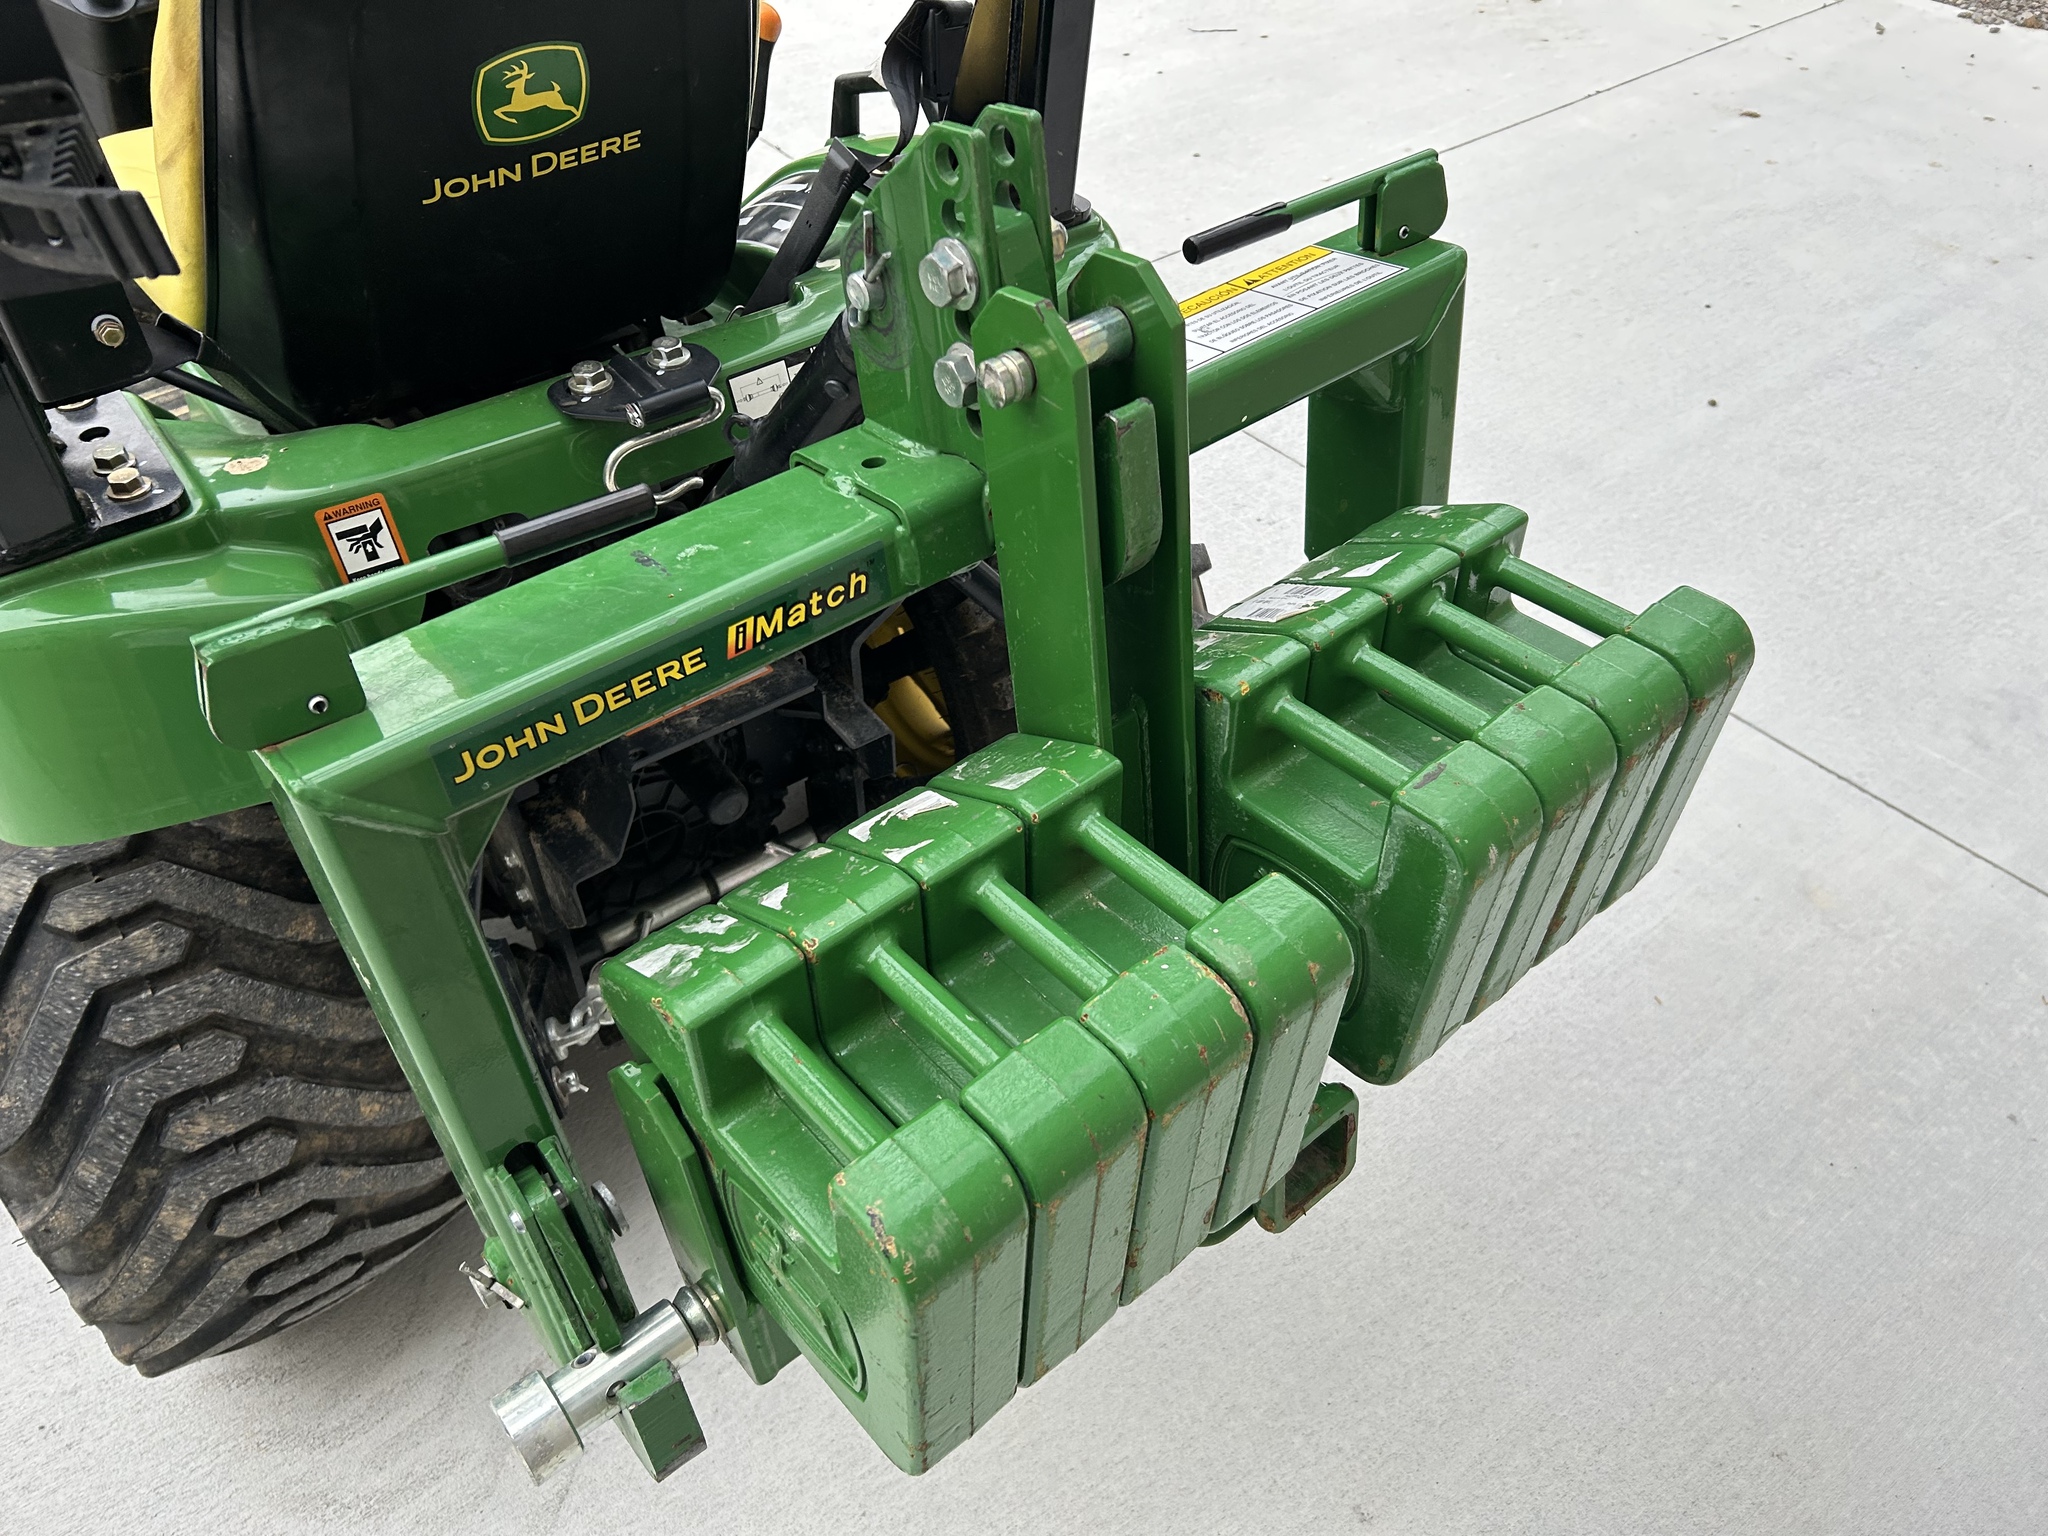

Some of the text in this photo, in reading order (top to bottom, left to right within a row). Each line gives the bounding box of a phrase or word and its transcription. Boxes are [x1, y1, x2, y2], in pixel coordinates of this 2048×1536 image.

[422, 129, 641, 205] JOHN DEERE
[1258, 252, 1316, 280] ATTENTION
[332, 498, 380, 518] WARNING
[453, 712, 567, 784] JOHN
[571, 647, 707, 726] DEERE
